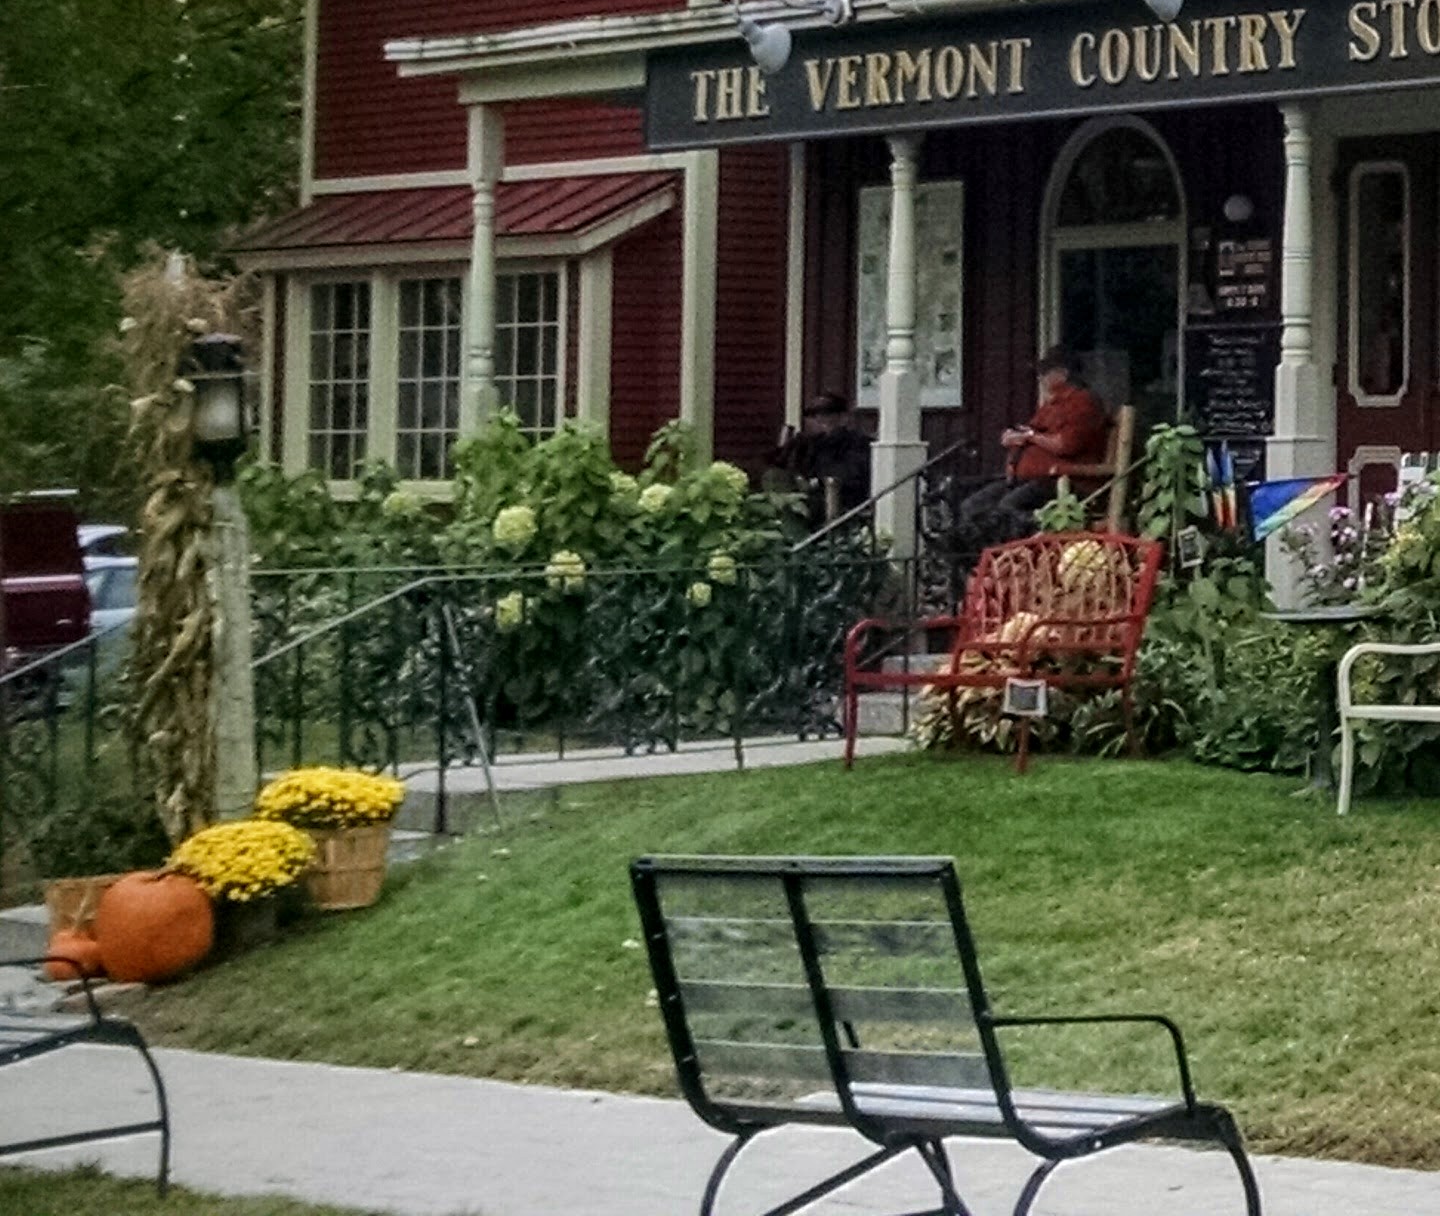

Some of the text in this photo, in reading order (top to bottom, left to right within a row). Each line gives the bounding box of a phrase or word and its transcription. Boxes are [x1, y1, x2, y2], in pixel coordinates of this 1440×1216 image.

[690, 65, 770, 123] THE
[803, 37, 1032, 113] VERMONT
[1069, 8, 1306, 87] COUNTRY
